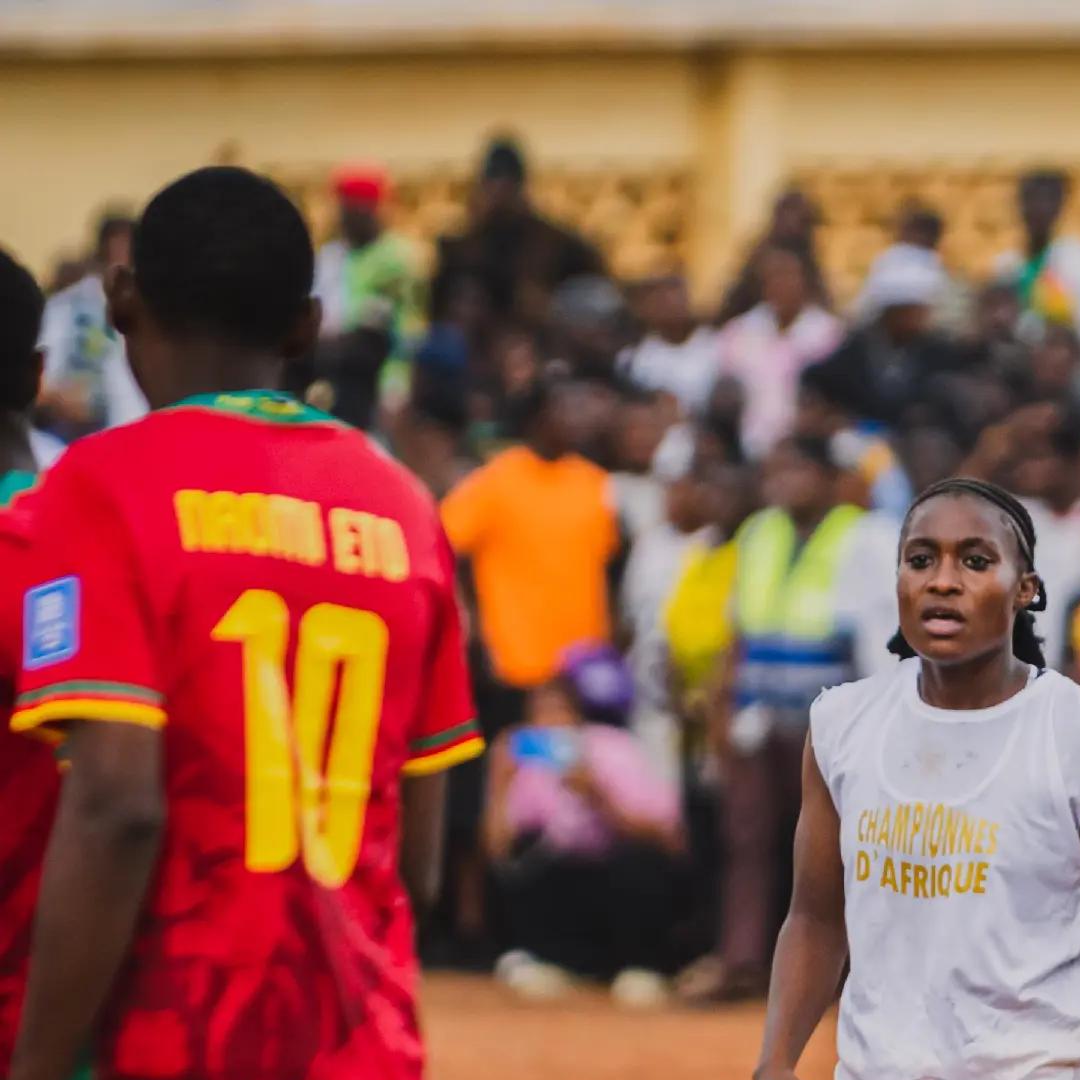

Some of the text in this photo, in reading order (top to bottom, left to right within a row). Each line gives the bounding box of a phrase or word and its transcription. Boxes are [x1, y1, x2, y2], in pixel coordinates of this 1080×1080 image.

[209, 587, 390, 890] 10
[857, 801, 1000, 858] CHAMPIONNES
[855, 849, 990, 899] D'AFRIQUE
